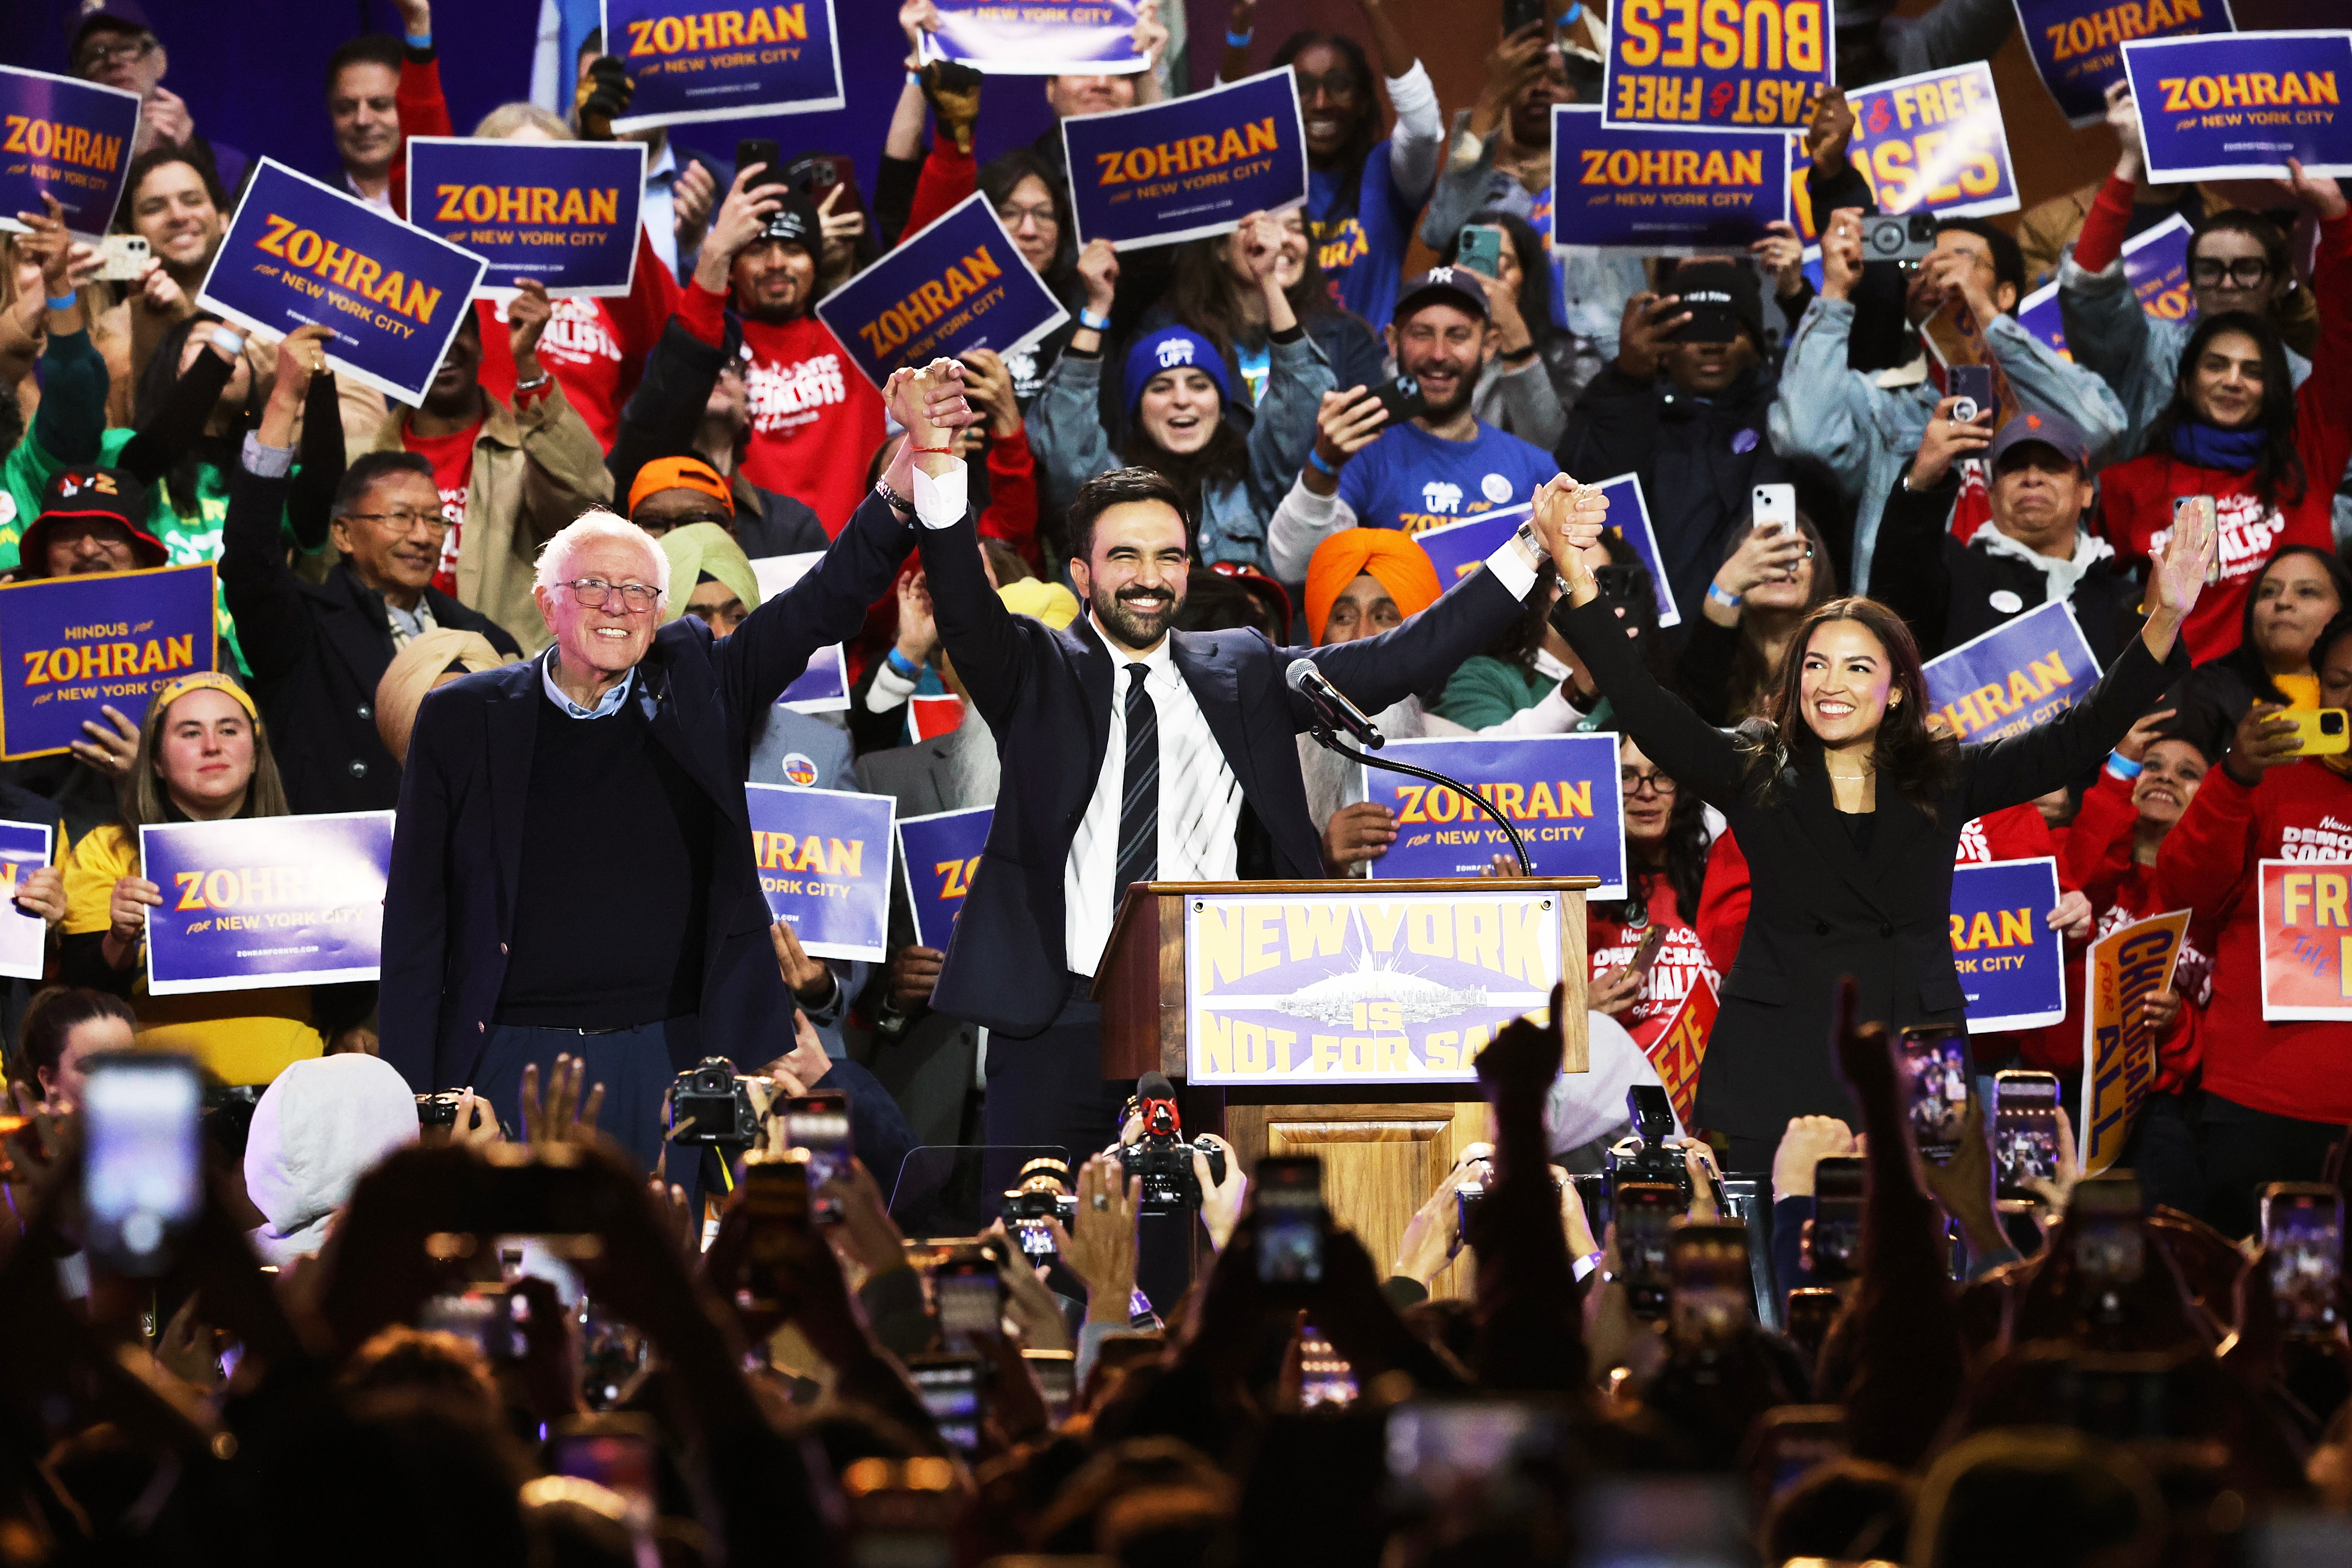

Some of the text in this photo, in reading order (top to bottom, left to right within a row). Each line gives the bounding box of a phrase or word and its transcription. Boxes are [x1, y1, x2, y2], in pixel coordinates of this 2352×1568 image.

[628, 3, 808, 57] ZOHRAN
[1621, 0, 1824, 72] BUSES
[2046, 0, 2203, 62] ZOHRAN
[664, 57, 706, 73] NEW
[710, 52, 757, 69] YORK
[760, 48, 801, 64] CITY
[1615, 74, 1703, 121] FREE
[1708, 81, 1734, 117] &
[1868, 98, 1892, 132] &
[1892, 74, 1986, 130] FREE
[2158, 70, 2340, 113] ZOHRAN
[2202, 113, 2242, 129] NEW
[2247, 111, 2291, 125] YORK
[2296, 111, 2335, 125] CITY
[2, 115, 121, 173] ZOHRAN
[1096, 117, 1279, 187] ZOHRAN
[31, 166, 61, 181] NEW
[64, 170, 87, 187] YORK
[88, 173, 108, 192] CITY
[1137, 181, 1179, 200] NEW
[1182, 171, 1230, 191] YORK
[1233, 159, 1273, 181] CITY
[1579, 149, 1763, 186] ZOHRAN
[435, 183, 619, 225] ZOHRAN
[1614, 192, 1657, 206] NEW
[1661, 193, 1708, 207] YORK
[1712, 193, 1754, 207] CITY
[471, 229, 514, 245] NEW
[519, 231, 567, 246] YORK
[569, 231, 608, 246] CITY
[254, 214, 442, 324] ZOHRAN
[282, 271, 326, 298] NEW
[328, 291, 373, 322] YORK
[375, 314, 415, 339] CITY
[859, 244, 1003, 360] ZOHRAN
[936, 310, 974, 340] YORK
[972, 286, 1006, 316] CITY
[65, 622, 128, 641] HINDUS
[24, 633, 194, 687] ZOHRAN
[57, 685, 97, 702] NEW
[101, 682, 146, 698] YORK
[1925, 649, 2073, 740] HRAN
[2032, 694, 2072, 724] CITY
[1395, 781, 1594, 824] ZOHRAN
[752, 830, 864, 878] RAN
[1406, 826, 1585, 848] FOR NEW YOK CITY
[759, 877, 851, 899] ORK CITY
[2282, 873, 2352, 928] FR
[187, 908, 365, 935] FOR NEW YORK CITY
[1950, 907, 2034, 952] RAN
[237, 946, 319, 958] ZOHRANFORNYC.COM
[1198, 903, 1549, 996] NEW YORK
[1955, 955, 2025, 974] RK CITY
[2294, 935, 2332, 977] THE
[1353, 1002, 1402, 1031] IS
[2118, 929, 2174, 1125] CHILDCAR
[1201, 1010, 1297, 1074] NOT
[1312, 1034, 1410, 1072] FOR
[1653, 1004, 1707, 1099] EZE
[2091, 1024, 2123, 1158] ALL
